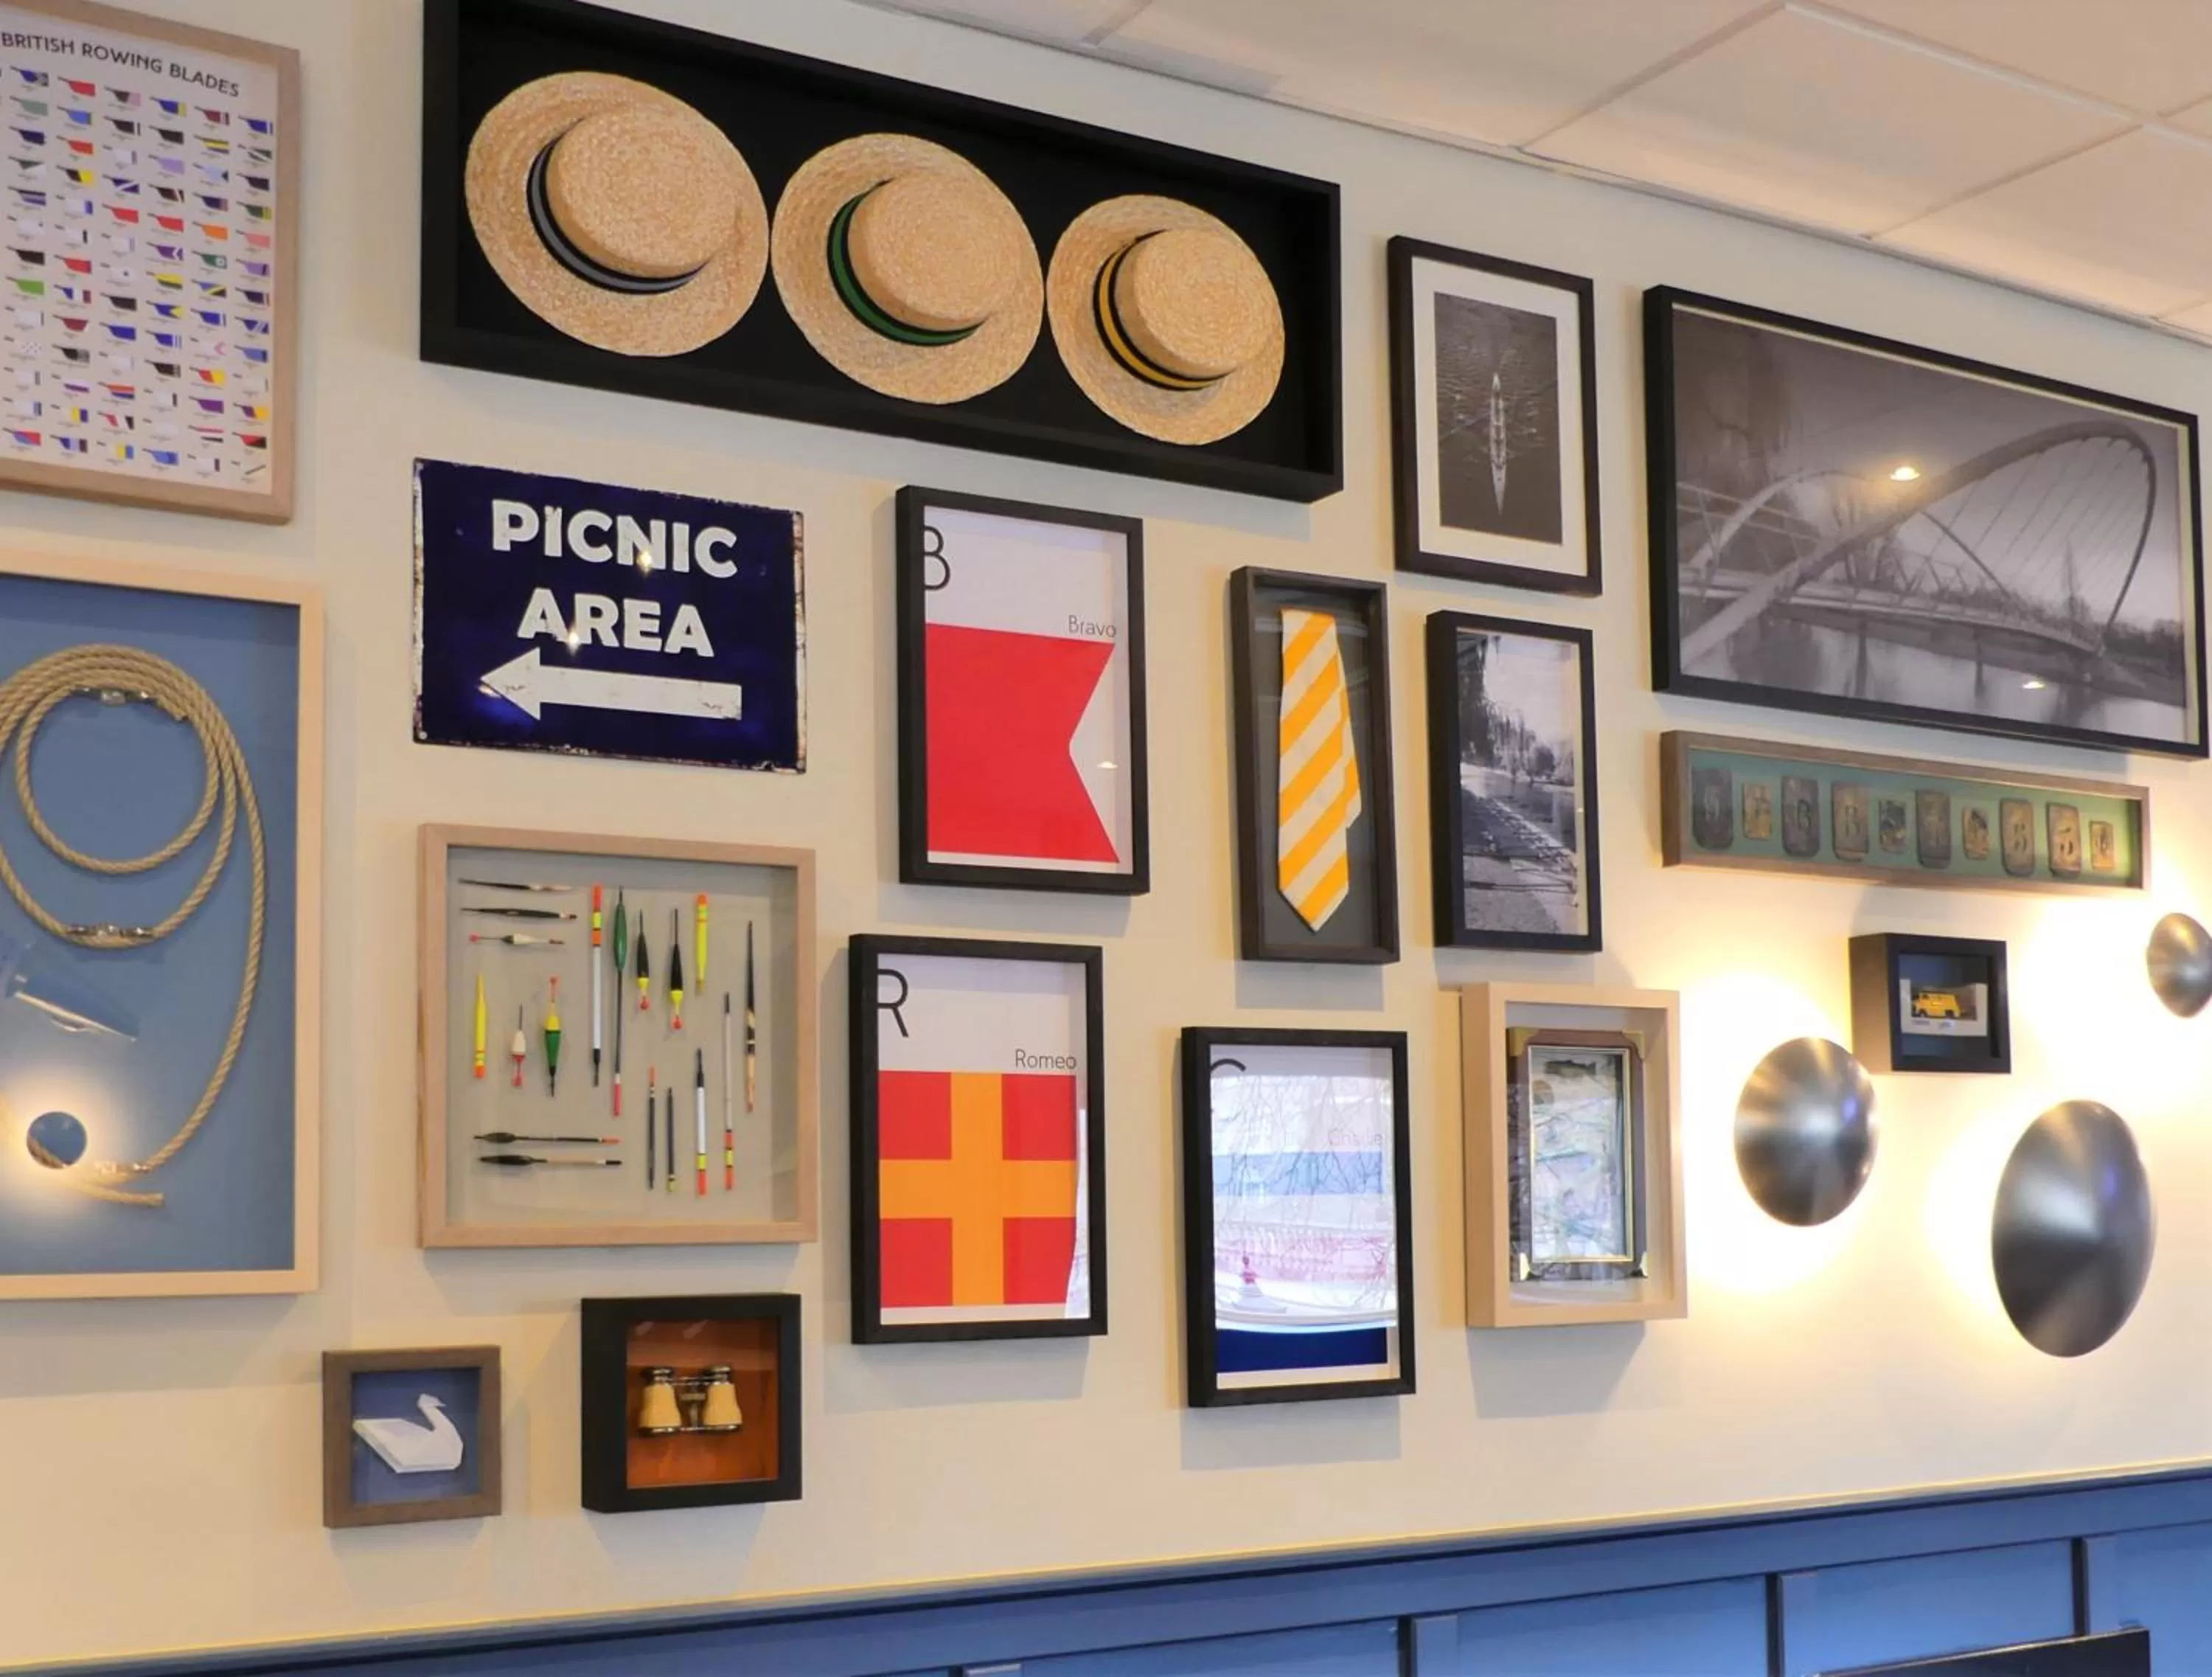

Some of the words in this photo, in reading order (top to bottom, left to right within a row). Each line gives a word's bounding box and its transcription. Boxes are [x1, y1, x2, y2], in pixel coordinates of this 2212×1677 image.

[1, 32, 74, 55] BRITISH
[82, 42, 162, 74] ROWING
[170, 62, 240, 97] BLADES
[491, 499, 738, 578] PICNIC
[924, 525, 950, 591] B
[518, 588, 714, 657] AREA
[1068, 614, 1117, 638] Bravo
[877, 968, 909, 1038] R
[1015, 1048, 1077, 1069] Romeo
